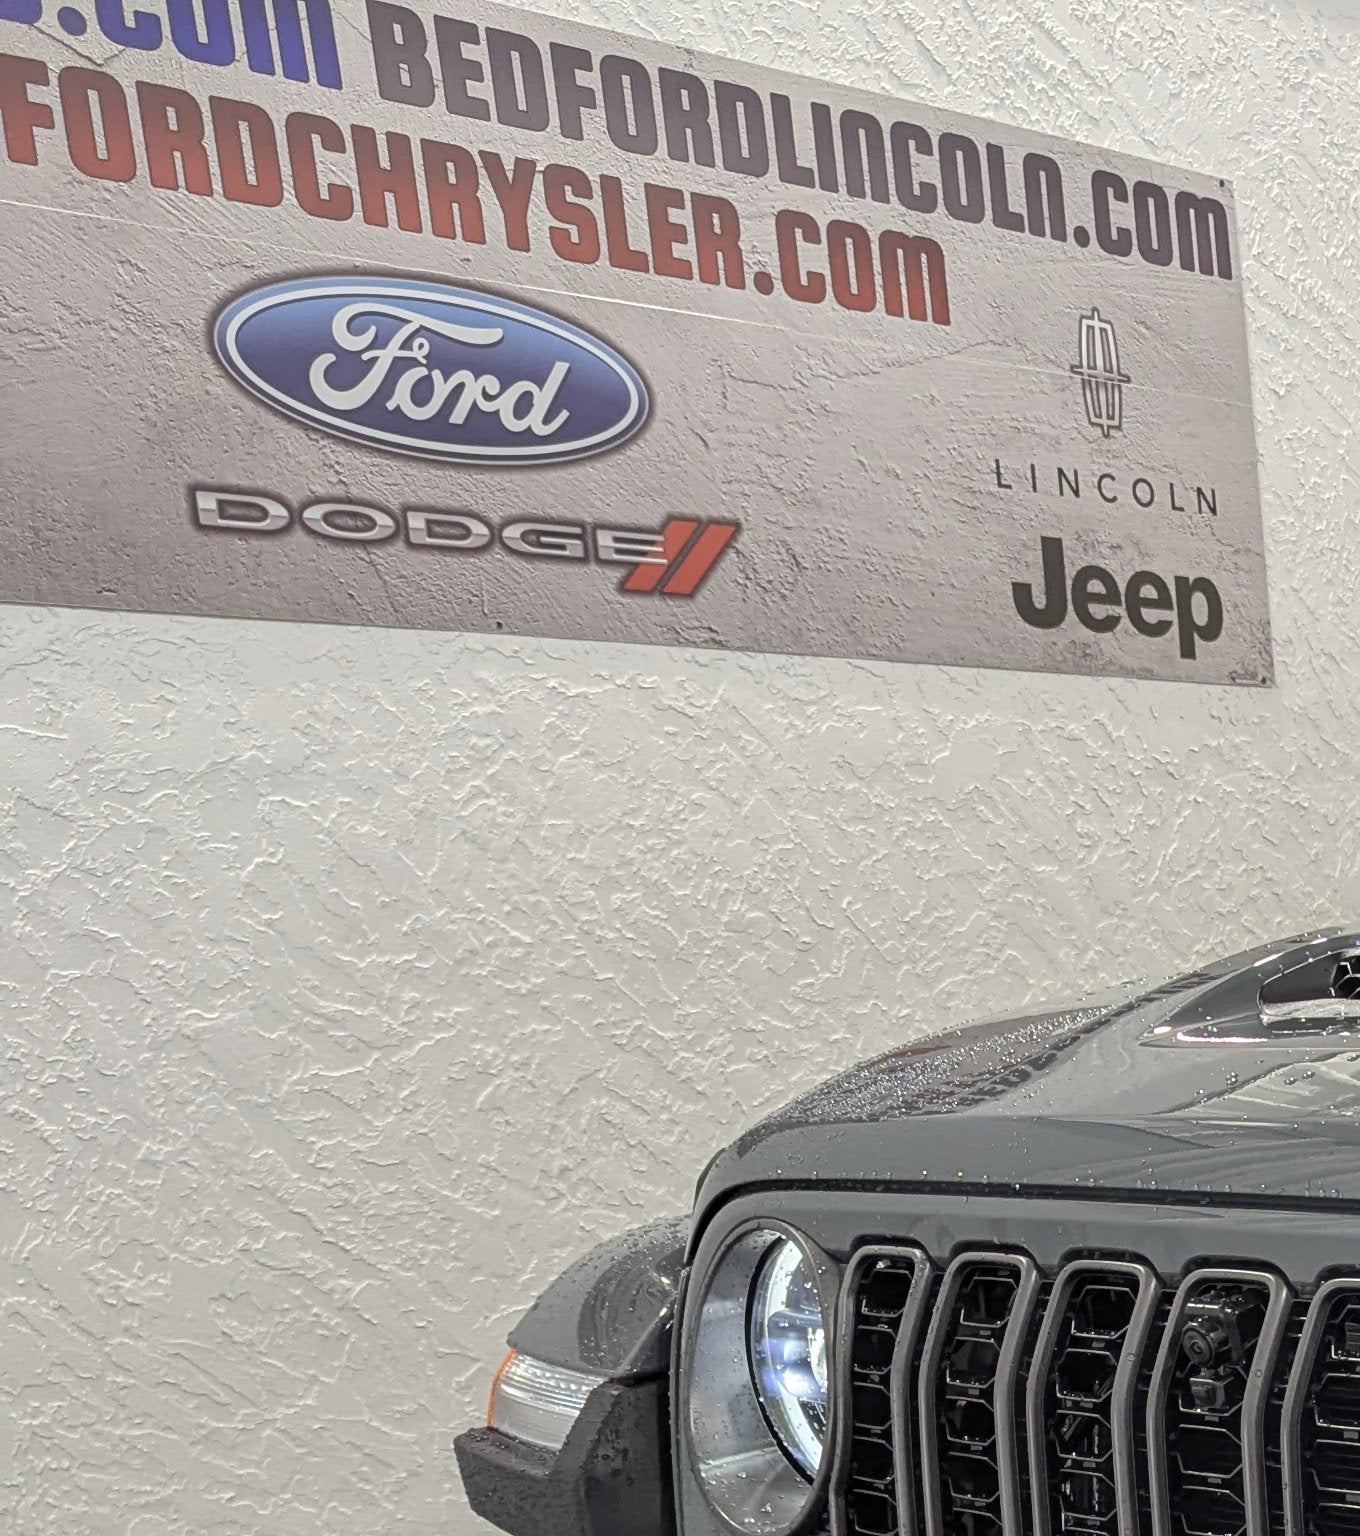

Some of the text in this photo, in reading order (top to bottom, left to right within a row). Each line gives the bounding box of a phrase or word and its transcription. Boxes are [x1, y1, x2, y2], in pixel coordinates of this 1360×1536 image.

[366, 0, 1234, 282] BEDFORDLINCOLN.COM
[308, 302, 571, 440] Ford
[193, 490, 668, 568] DODGE
[993, 456, 1219, 518] LINCOLN
[1010, 536, 1225, 661] Jeep
